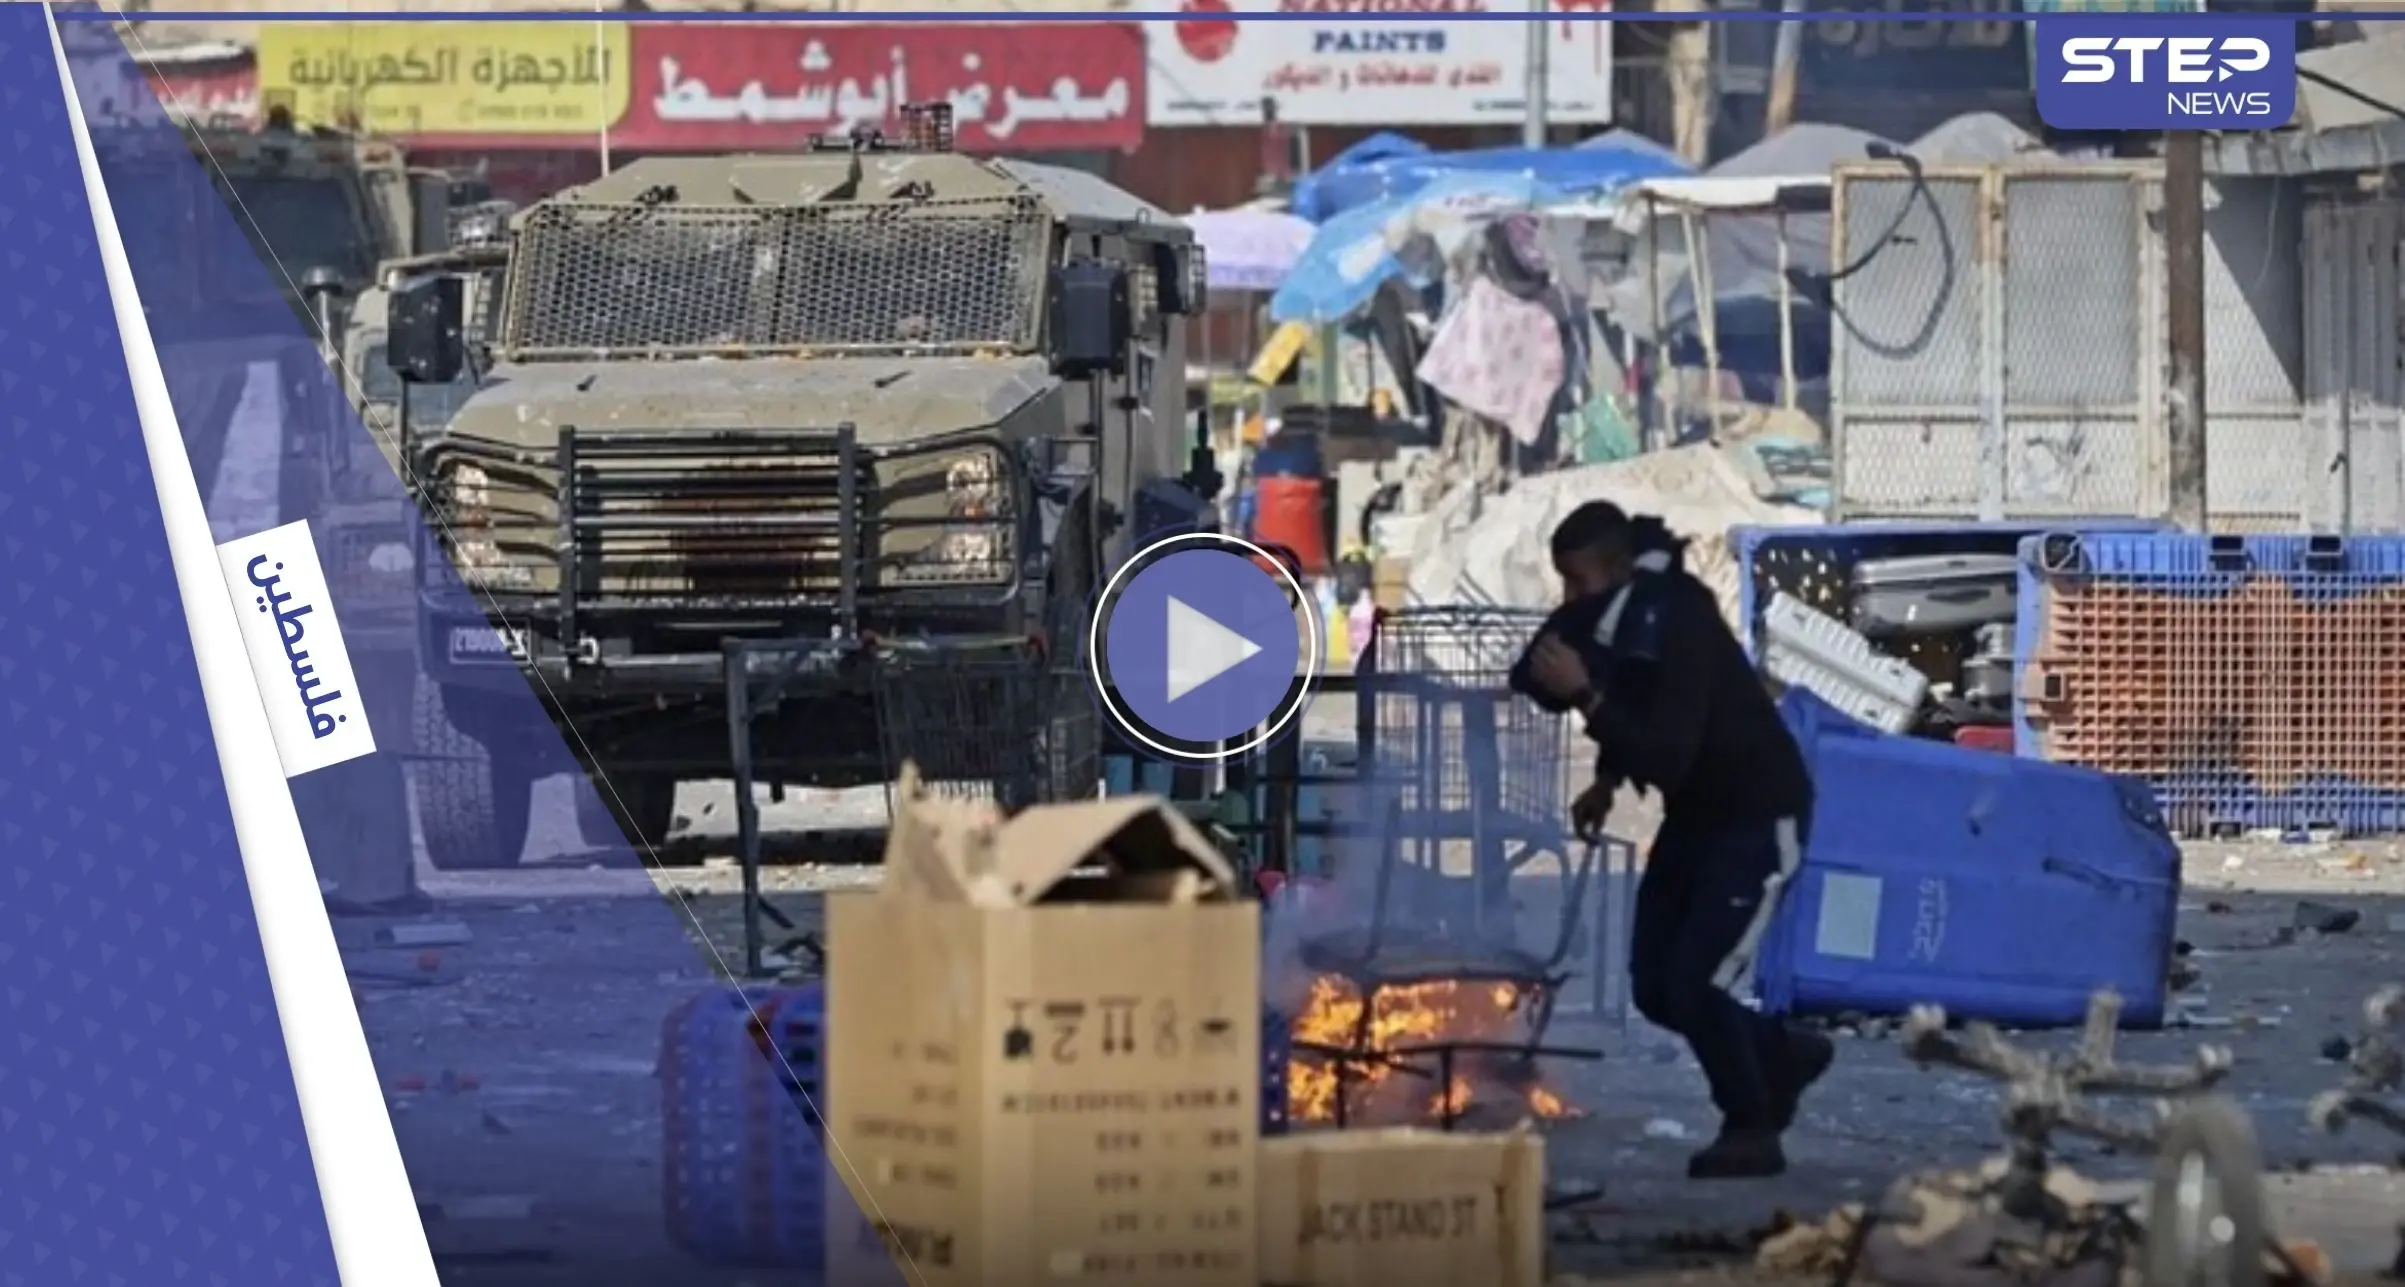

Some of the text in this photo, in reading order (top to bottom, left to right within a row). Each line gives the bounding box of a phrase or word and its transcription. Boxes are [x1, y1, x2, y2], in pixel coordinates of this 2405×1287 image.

[1313, 31, 1446, 53] PAINTS
[289, 44, 457, 93] الكهربائية
[942, 52, 1129, 137] معرض
